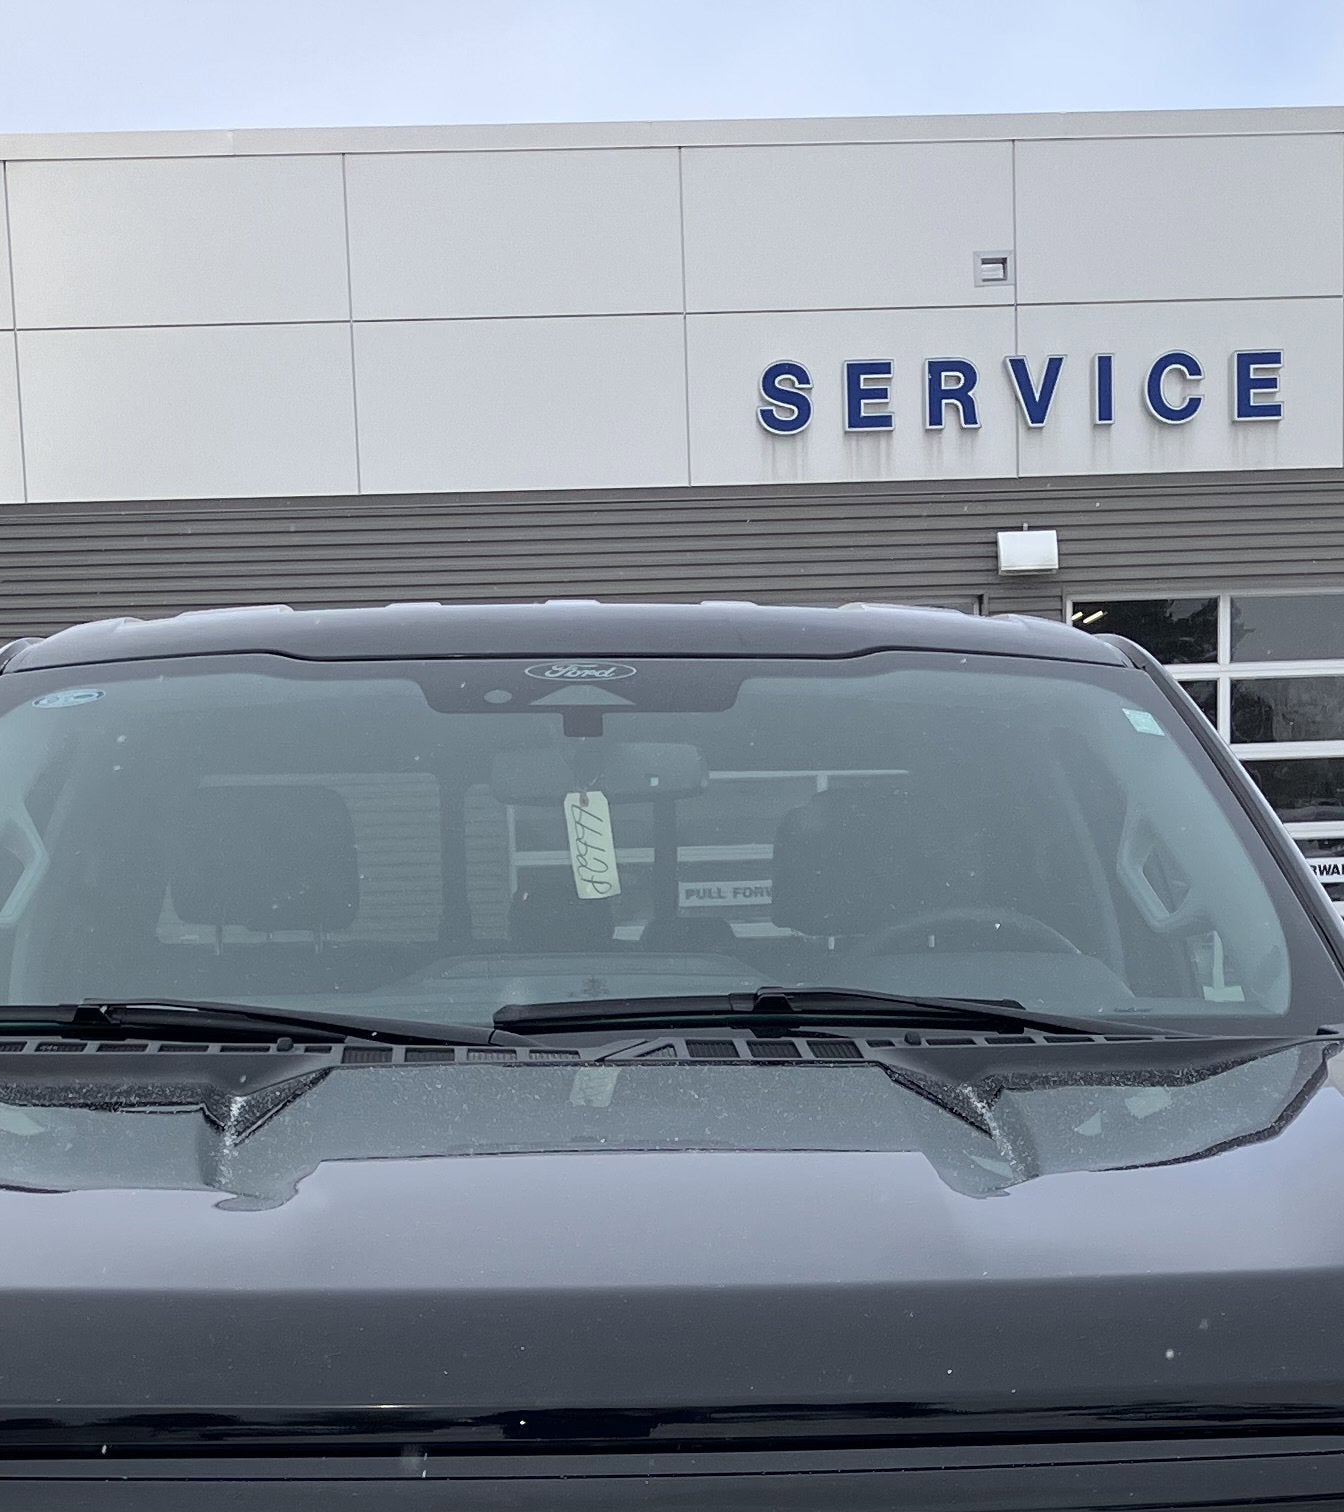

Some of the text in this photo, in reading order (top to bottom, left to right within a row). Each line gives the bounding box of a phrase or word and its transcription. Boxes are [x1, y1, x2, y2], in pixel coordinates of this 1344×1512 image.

[757, 348, 1286, 436] SERVICE
[544, 662, 617, 680] Ford
[684, 887, 727, 900] PULL
